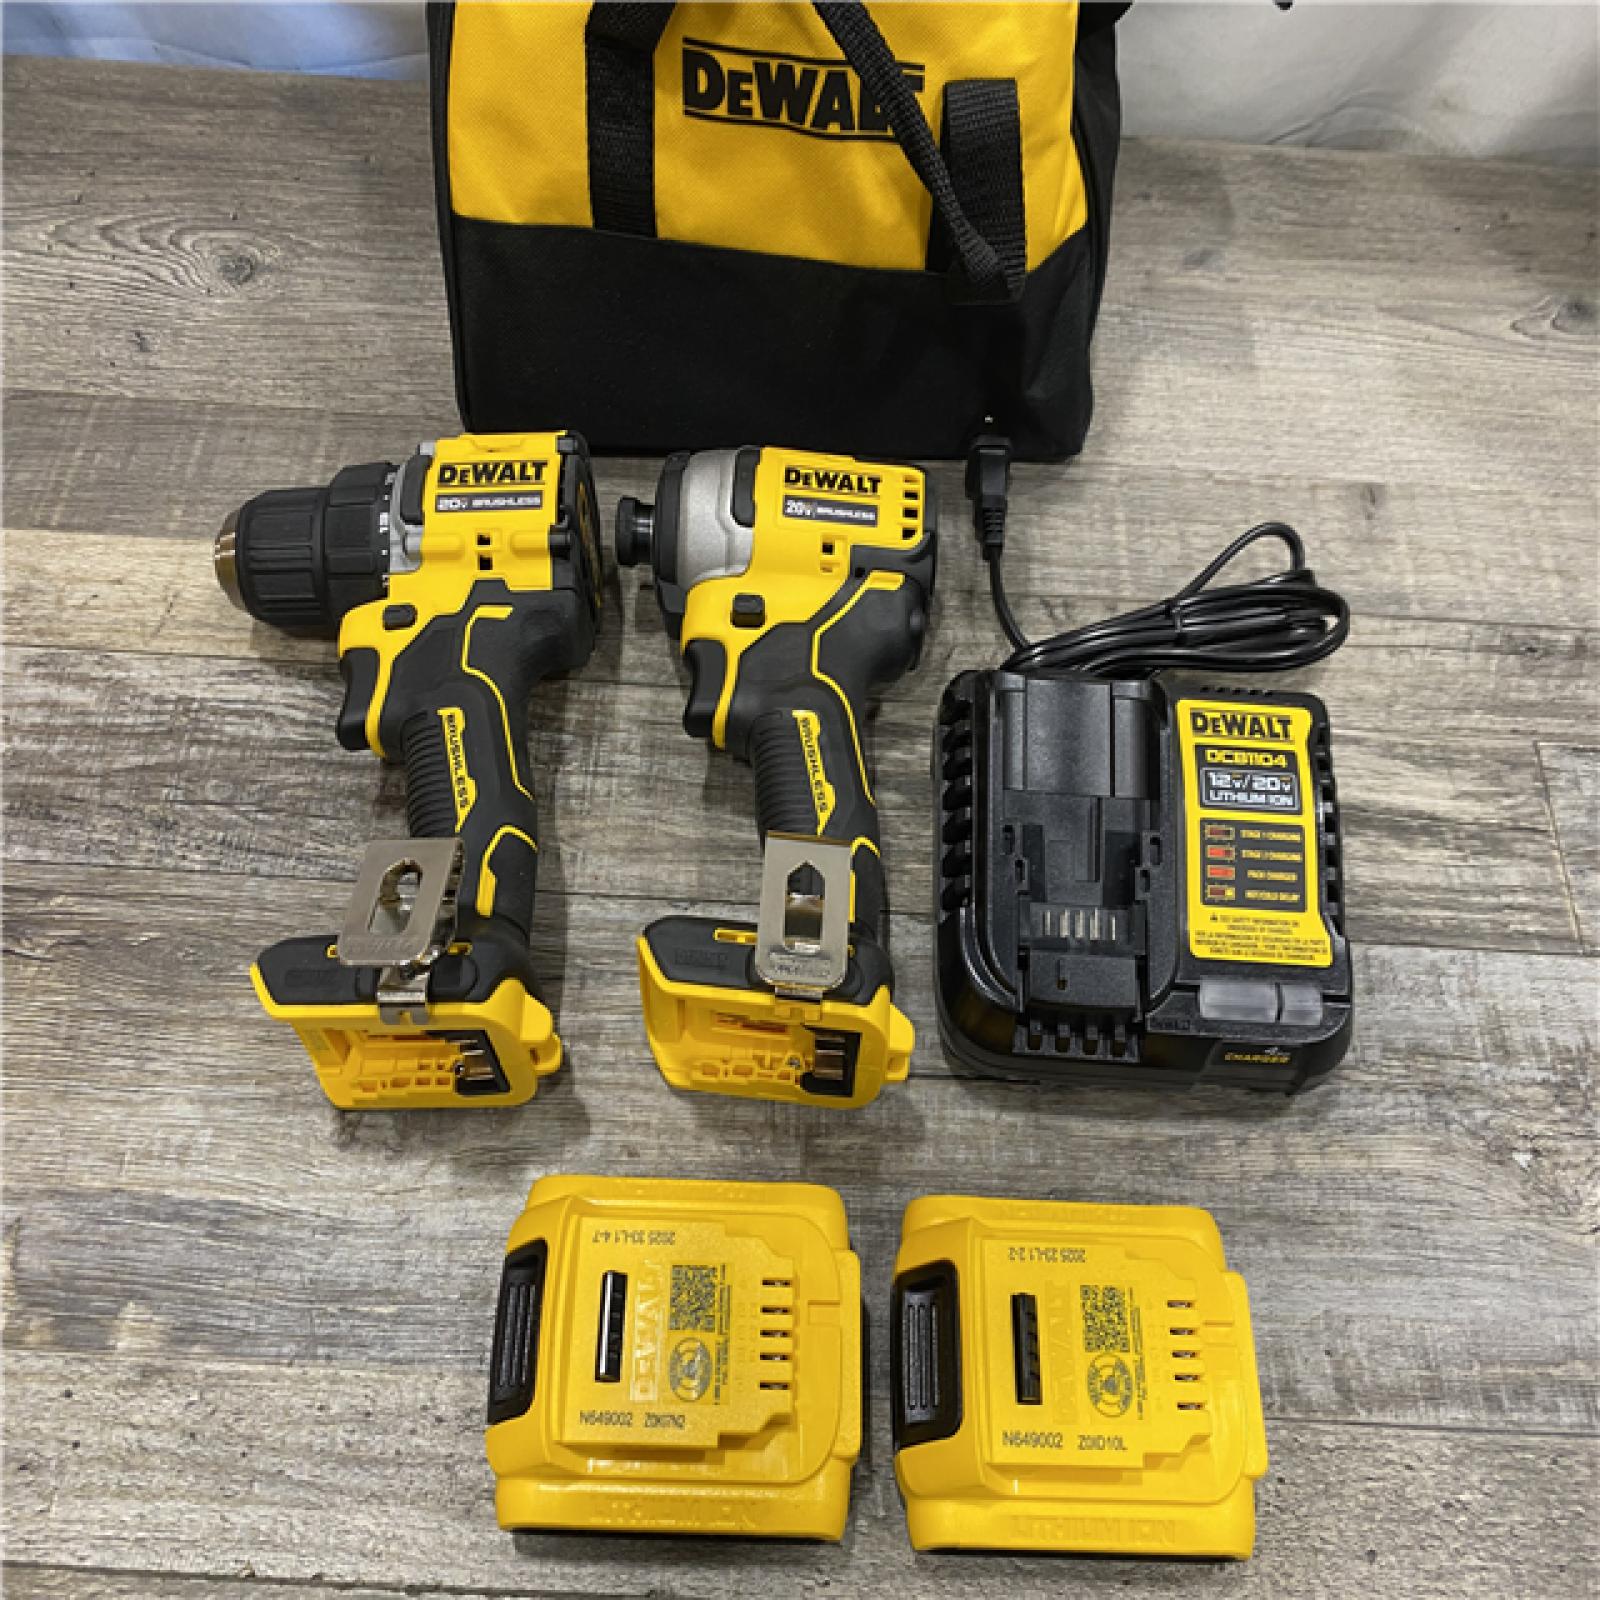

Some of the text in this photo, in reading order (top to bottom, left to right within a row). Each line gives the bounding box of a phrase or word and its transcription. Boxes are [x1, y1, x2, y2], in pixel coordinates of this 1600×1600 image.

[439, 461, 548, 484] DEWALT
[784, 468, 882, 493] DEWALT
[1191, 712, 1292, 739] DEWALT
[447, 713, 468, 809] BRUSHLESS
[801, 716, 828, 813] BRUSHLESS
[1209, 790, 1294, 806] LITHIUM ION
